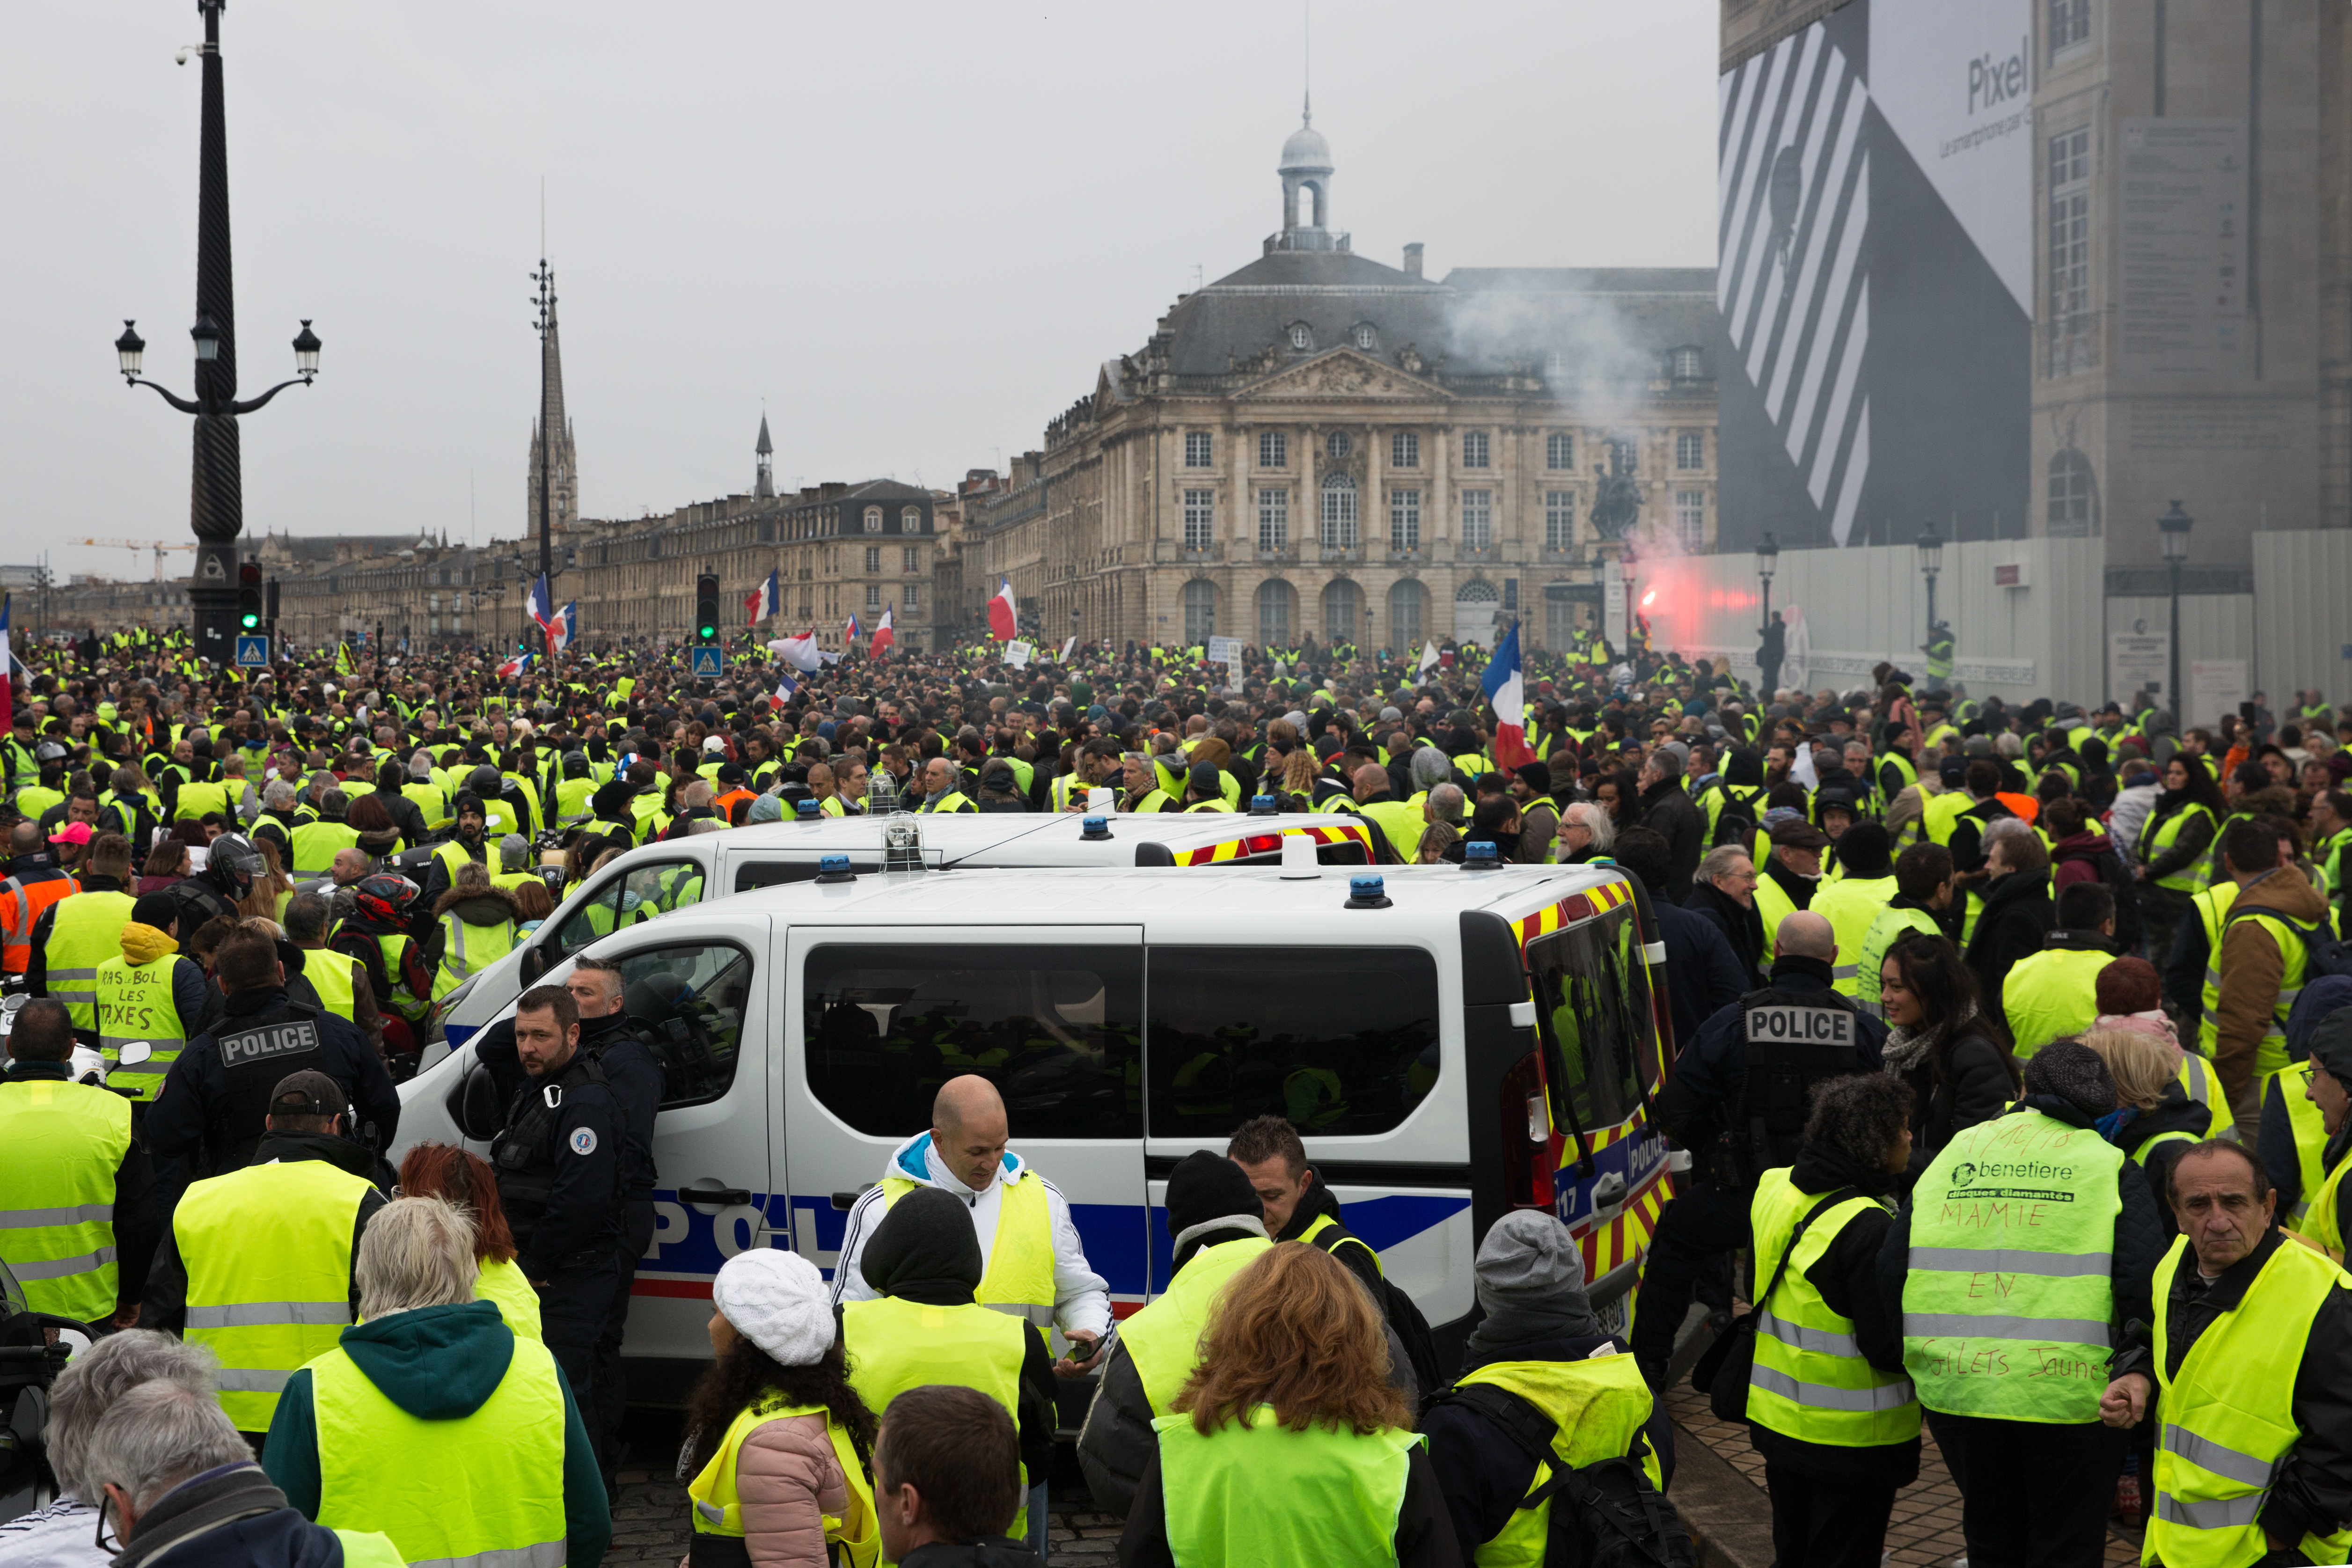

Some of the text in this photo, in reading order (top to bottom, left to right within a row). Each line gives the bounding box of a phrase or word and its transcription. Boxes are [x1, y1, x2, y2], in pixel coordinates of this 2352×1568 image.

[1968, 35, 2027, 115] Pixel
[101, 970, 161, 985] RAS Le BOL
[119, 989, 146, 1002] LES
[100, 1004, 153, 1030] TAXES
[1752, 1011, 1847, 1040] POLICE
[224, 1026, 314, 1061] POLICE
[1560, 1186, 1576, 1217] 17
[1949, 1189, 2072, 1201] disques diamantés
[1940, 1202, 2048, 1228] MAMIE
[643, 1201, 842, 1269] POL
[1969, 1272, 2017, 1298] EN
[2028, 1347, 2112, 1380] Jaunes
